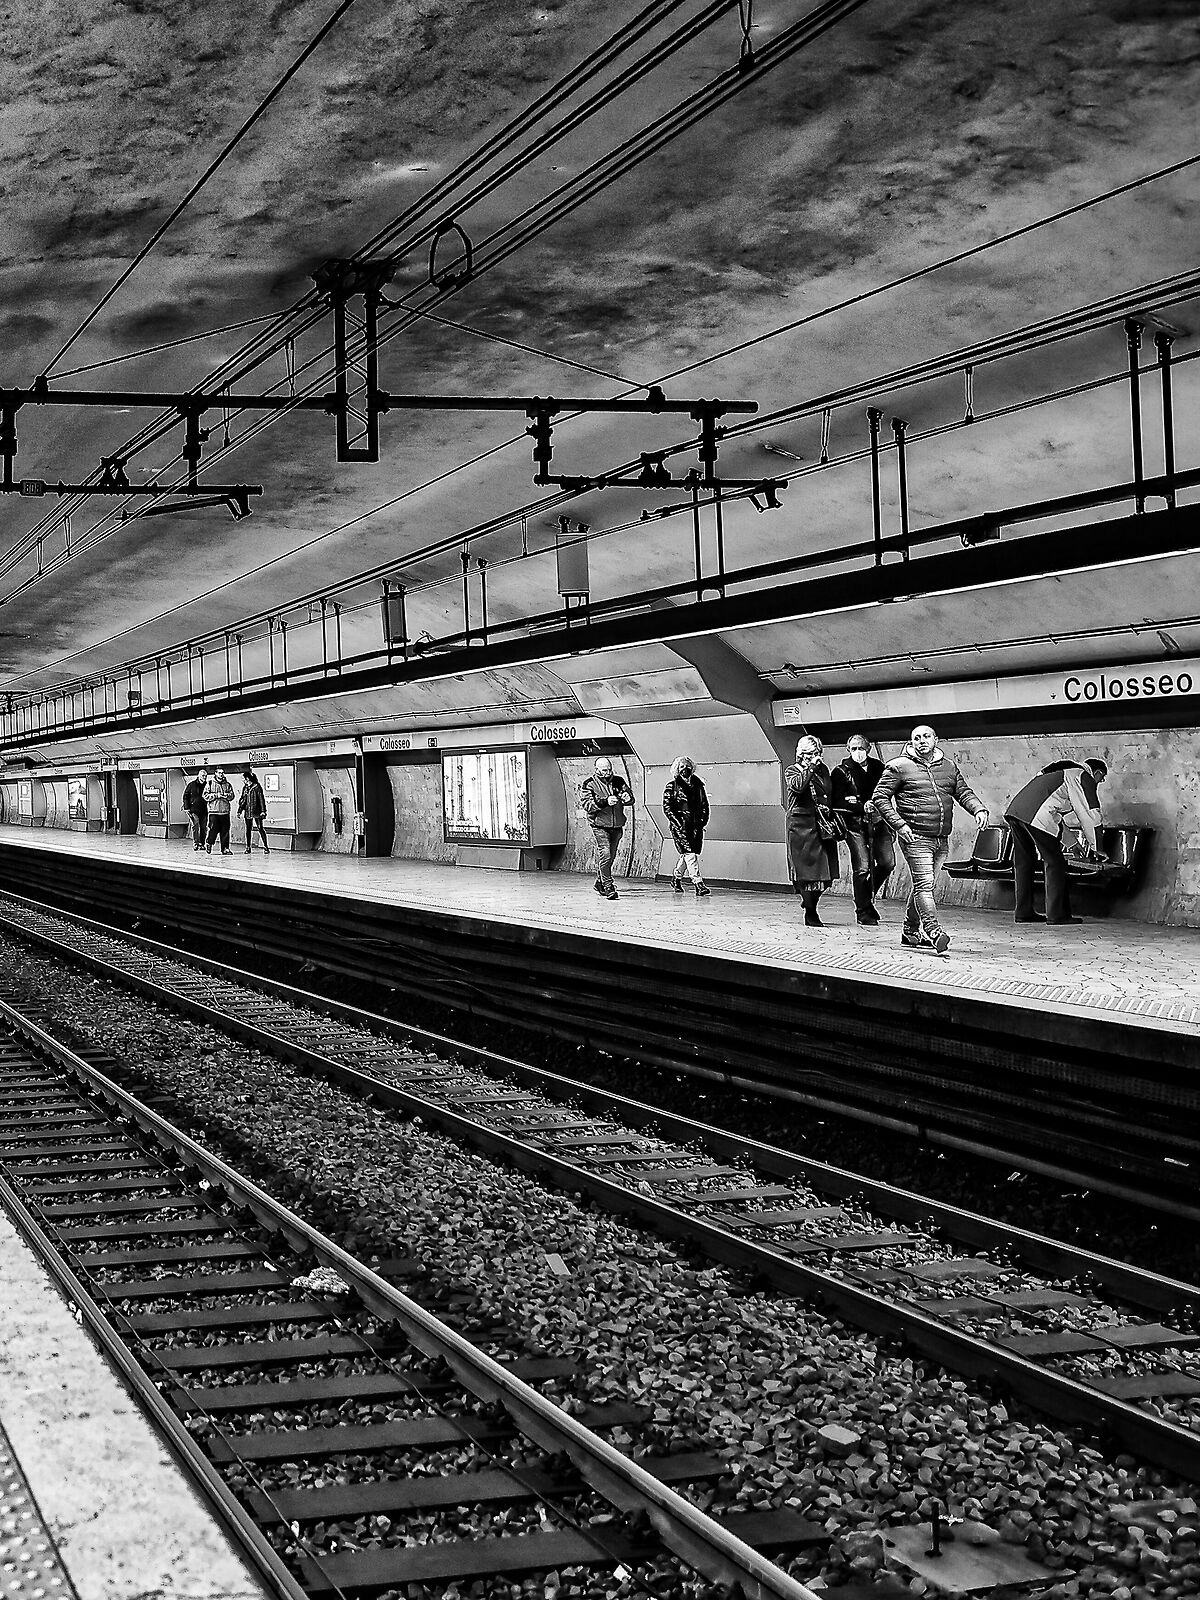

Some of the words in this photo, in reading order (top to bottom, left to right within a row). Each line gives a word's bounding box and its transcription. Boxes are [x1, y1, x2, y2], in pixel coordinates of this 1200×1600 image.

[1064, 673, 1193, 702] Colosseo
[531, 725, 576, 741] Colosseo
[380, 738, 410, 750] Colosseo
